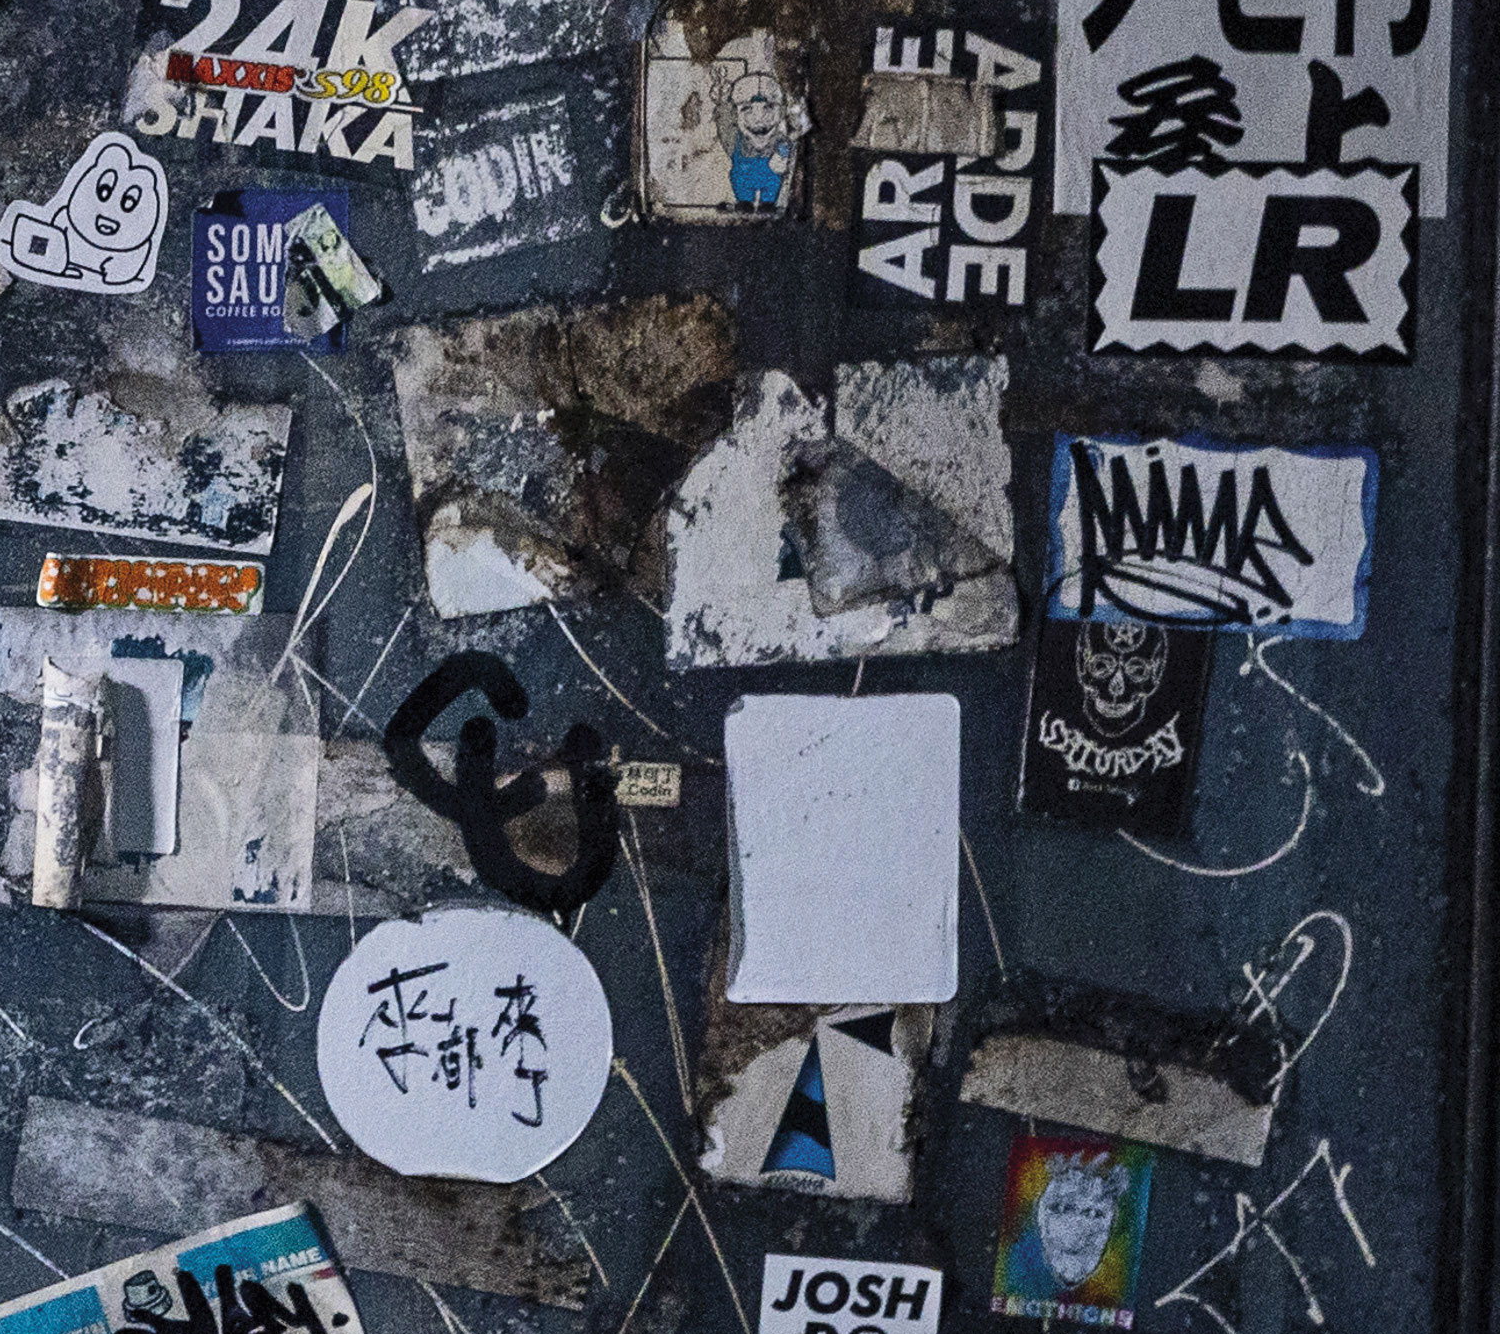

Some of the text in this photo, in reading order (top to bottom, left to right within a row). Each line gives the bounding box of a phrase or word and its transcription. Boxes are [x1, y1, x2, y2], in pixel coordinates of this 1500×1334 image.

[858, 26, 954, 302] ARE
[206, 223, 283, 264] SOM
[1130, 192, 1382, 324] LR
[206, 265, 279, 305] SAU
[205, 305, 284, 318] COFFEE RO
[260, 1246, 323, 1276] NAME
[771, 1268, 931, 1321] JOSH
